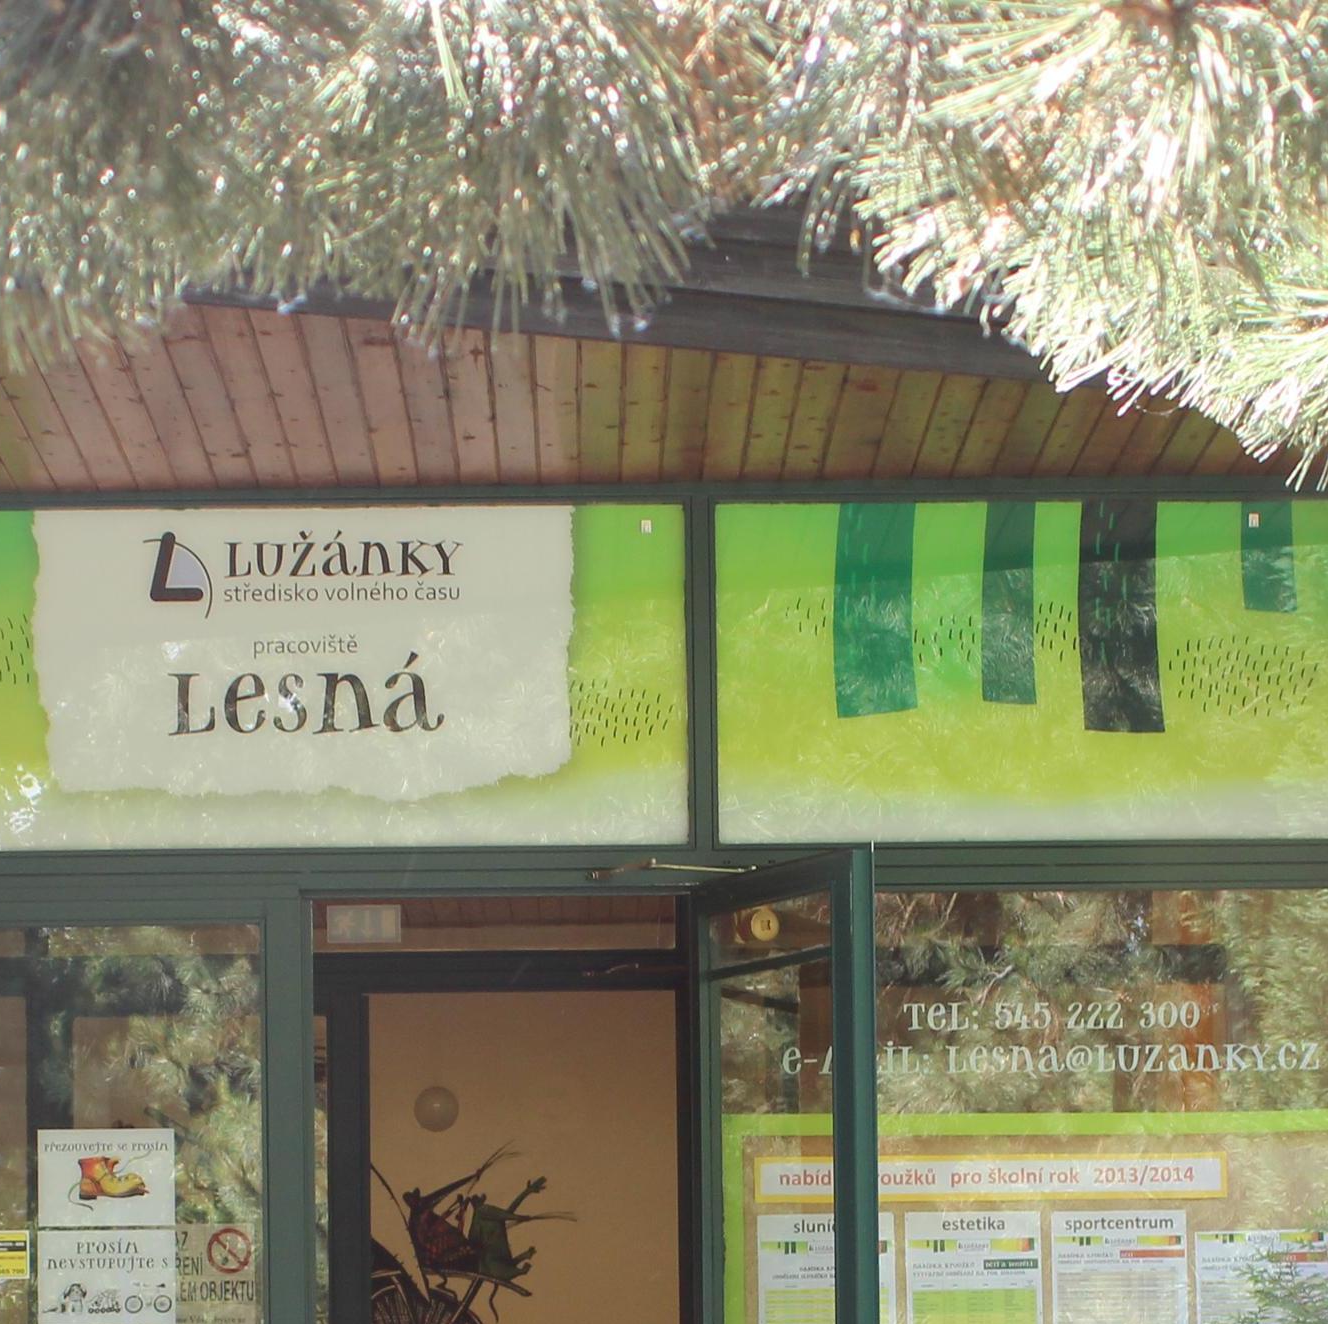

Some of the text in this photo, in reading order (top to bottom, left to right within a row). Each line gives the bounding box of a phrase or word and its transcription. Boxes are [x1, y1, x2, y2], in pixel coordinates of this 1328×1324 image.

[223, 578, 461, 602] středisko volného času
[252, 634, 359, 659] pracoviště
[167, 651, 444, 737] Lesná
[994, 1002, 1052, 1031] 545
[1067, 1002, 1124, 1030] 222
[1139, 1001, 1201, 1029] 300
[779, 1165, 1195, 1190] nabíd oužků pro školní rok 2013/2014
[941, 1215, 1006, 1232] estetika
[1064, 1217, 1174, 1234] sportcentrum
[200, 1280, 255, 1302] OBJEKTU
